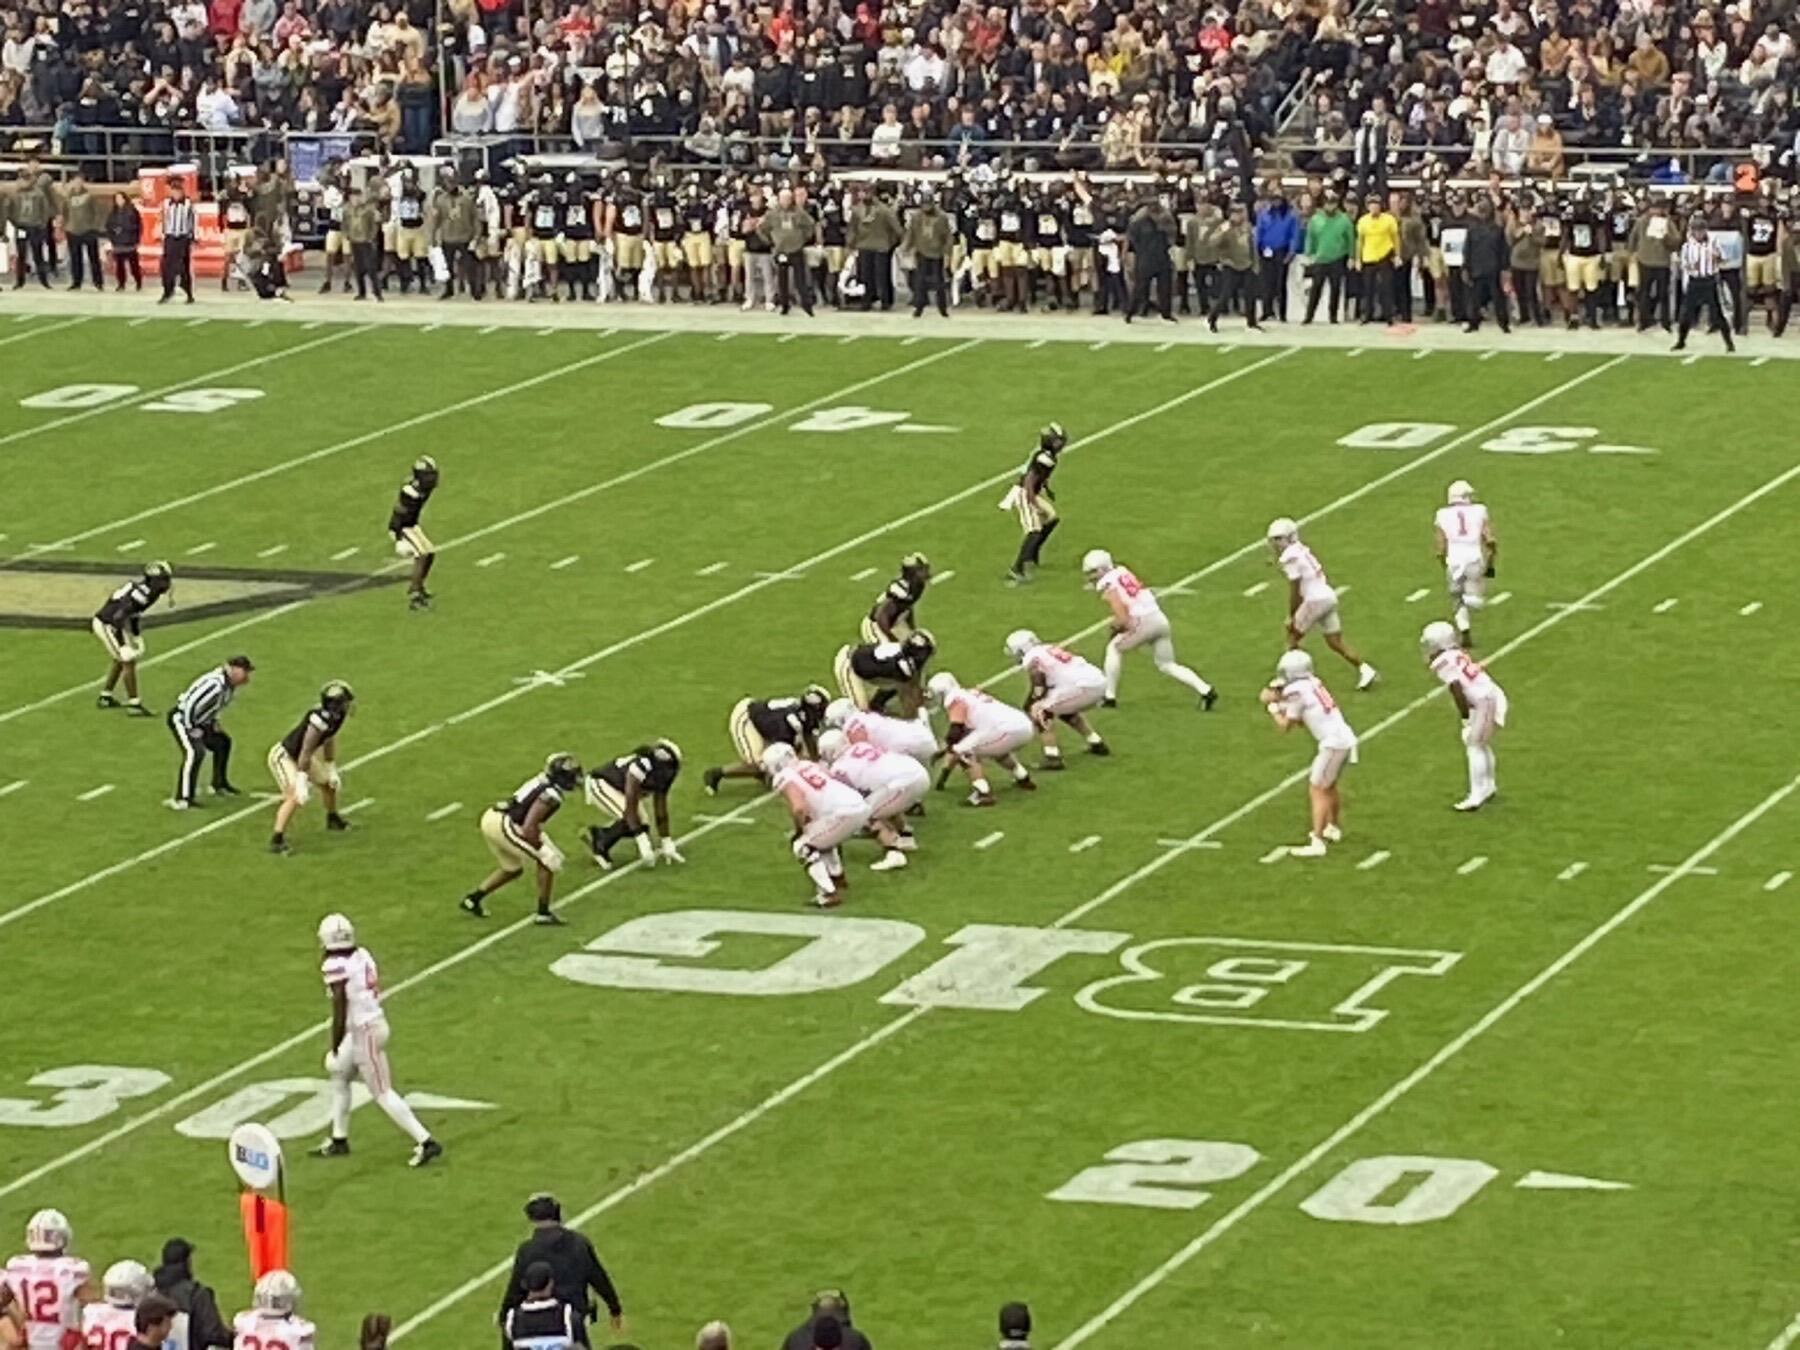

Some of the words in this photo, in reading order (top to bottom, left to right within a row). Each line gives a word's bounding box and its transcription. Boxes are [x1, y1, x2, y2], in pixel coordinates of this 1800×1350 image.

[653, 402, 912, 431] 40
[1335, 422, 1599, 453] 30
[1456, 510, 1468, 536] 1
[0, 1064, 380, 1139] 30
[1043, 1138, 1500, 1225] 20
[20, 1277, 60, 1324] 12
